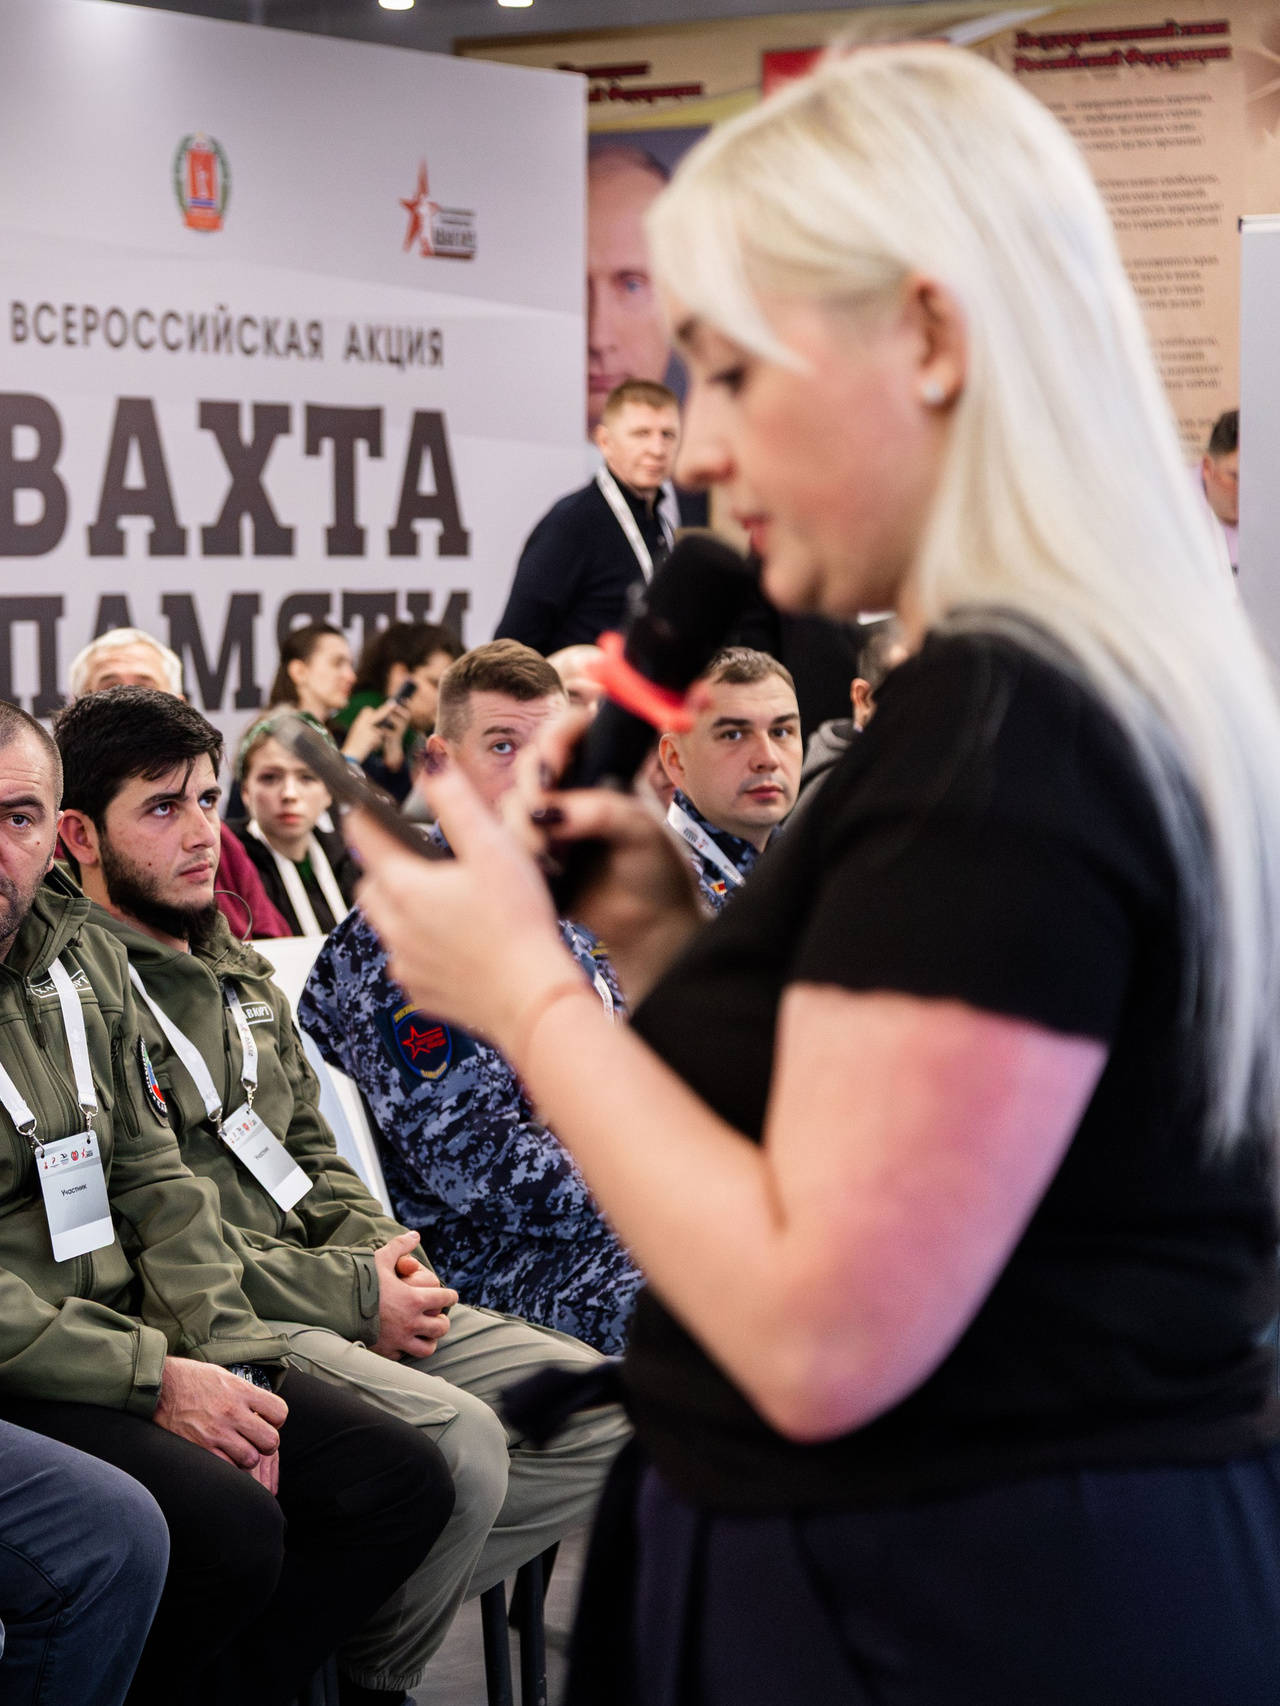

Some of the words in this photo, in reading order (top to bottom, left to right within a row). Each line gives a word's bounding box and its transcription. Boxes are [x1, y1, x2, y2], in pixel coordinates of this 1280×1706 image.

[10, 301, 324, 361] ВСЕРОССИЙСКАЯ
[344, 322, 444, 372] АКЦИЯ
[60, 1184, 87, 1197] Участник
